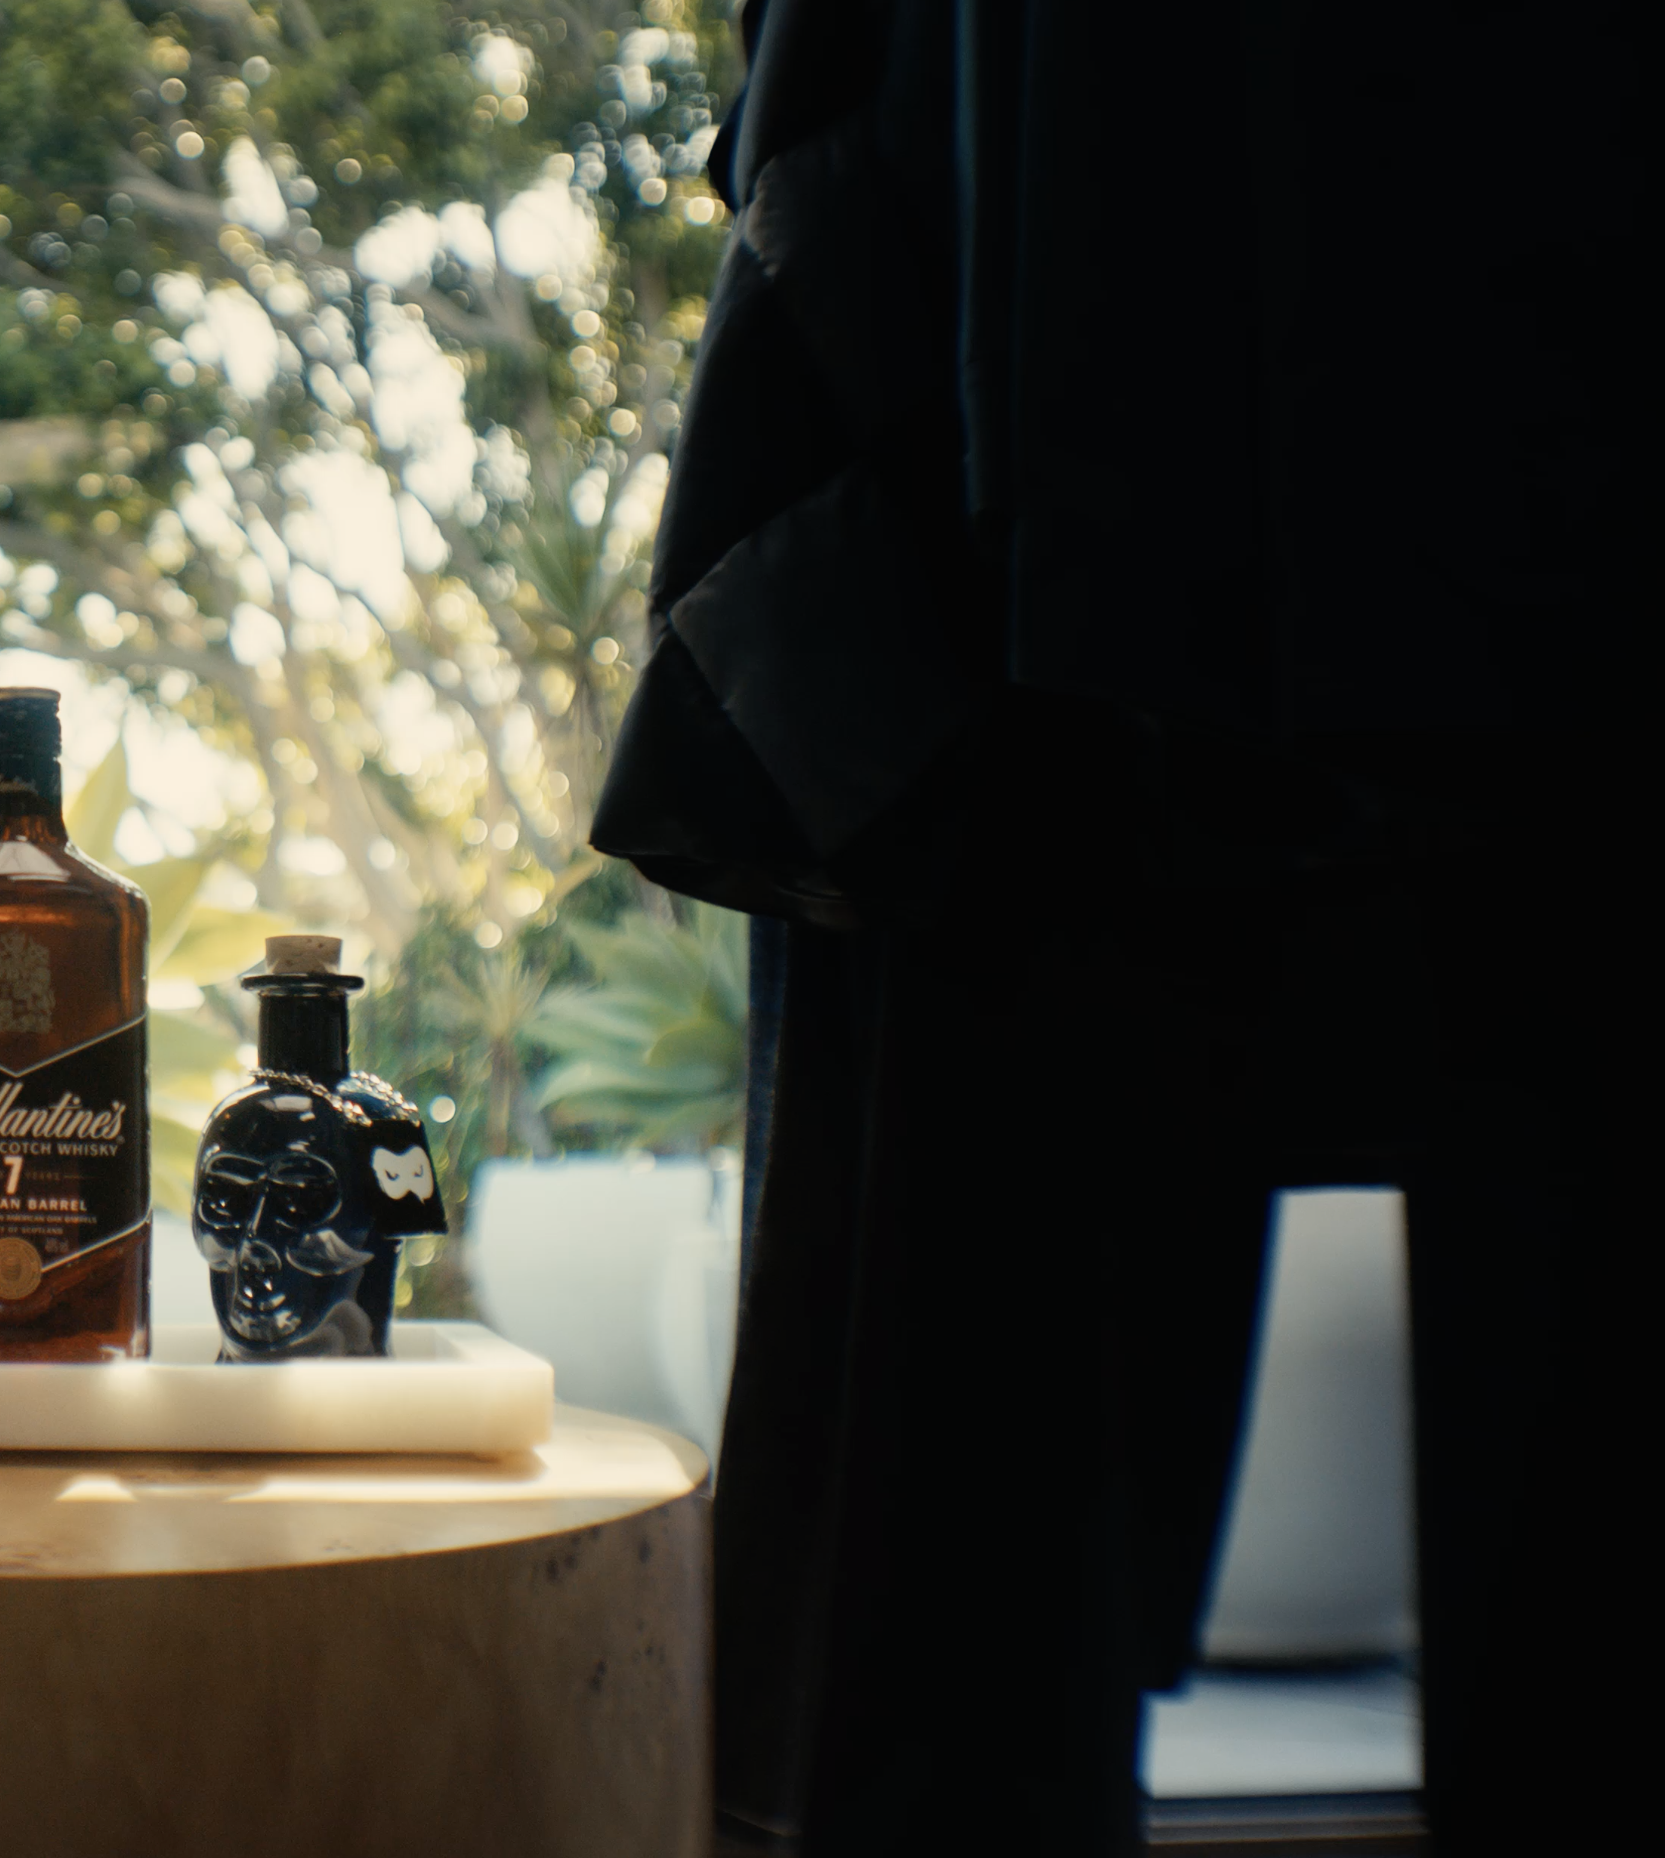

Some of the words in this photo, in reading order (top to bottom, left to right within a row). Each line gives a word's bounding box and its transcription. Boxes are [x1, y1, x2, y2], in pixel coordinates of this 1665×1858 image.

[57, 1142, 119, 1157] WHISKY
[3, 1155, 24, 1195] 7
[27, 1198, 88, 1212] BARREL
